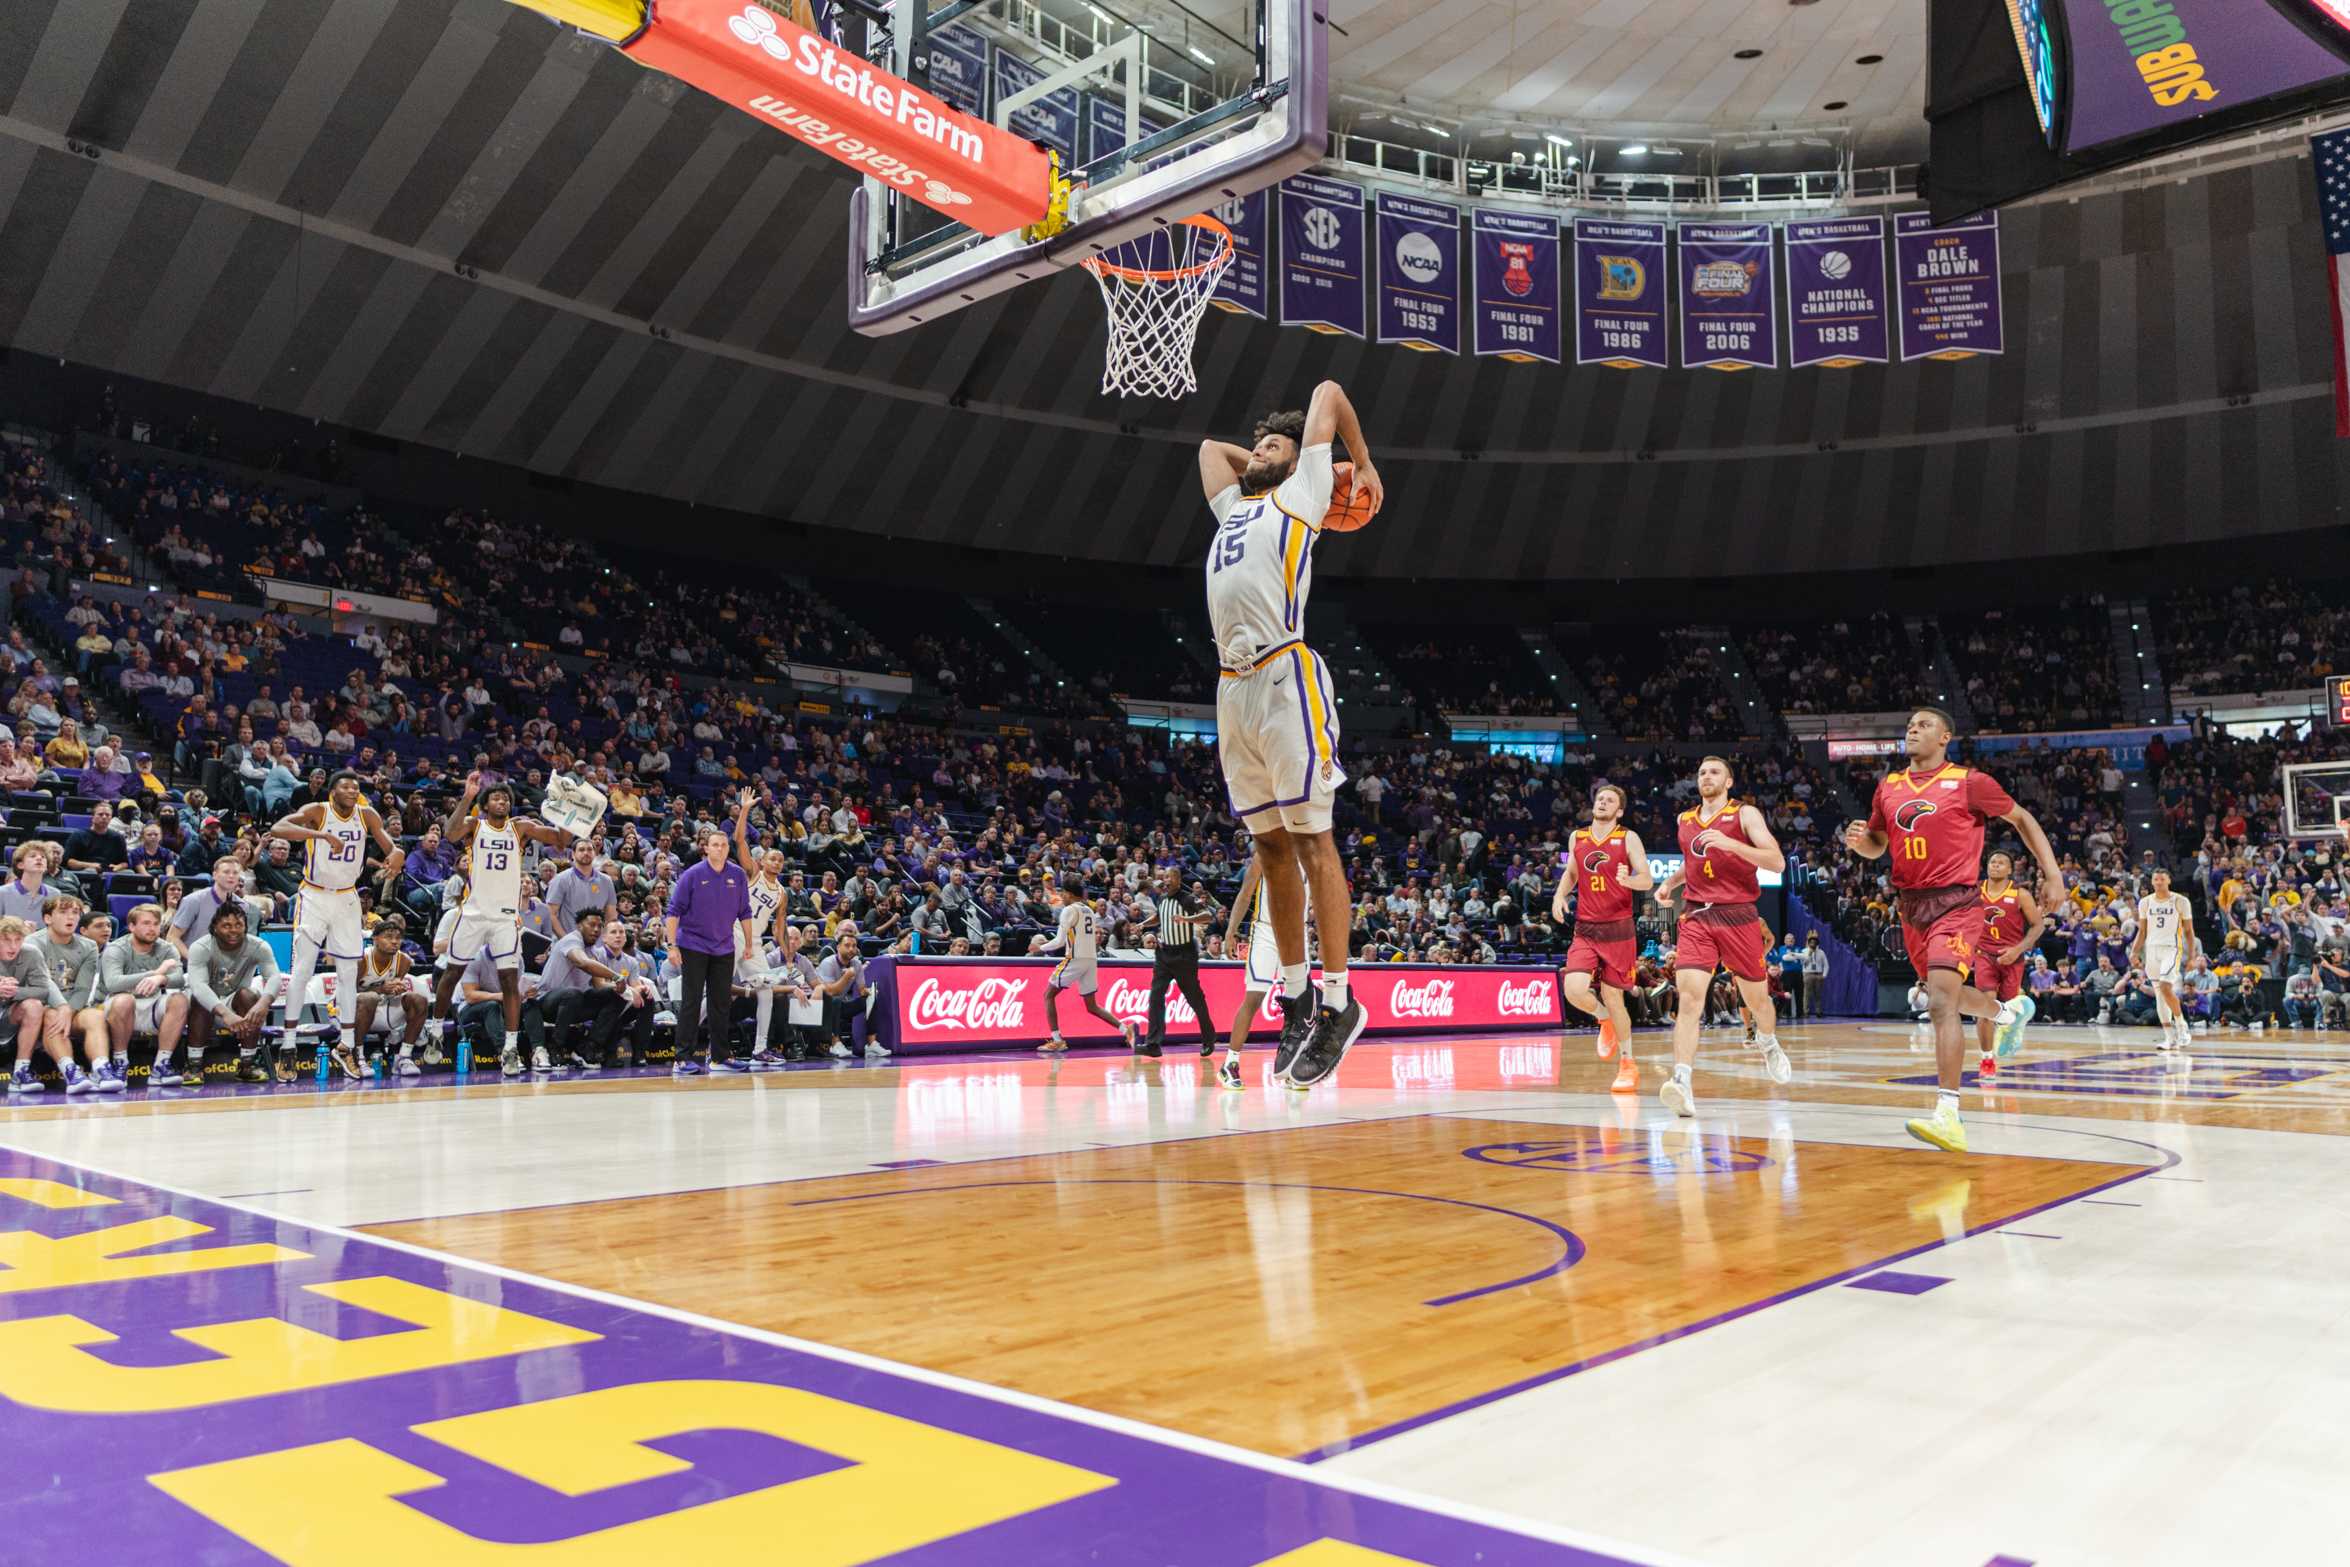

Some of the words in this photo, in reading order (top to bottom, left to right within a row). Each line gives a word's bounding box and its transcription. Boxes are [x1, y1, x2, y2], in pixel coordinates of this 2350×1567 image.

[2104, 0, 2220, 106] SUBWA
[1303, 207, 1341, 250] SEC
[1824, 223, 1869, 234] BASKETBALL
[1300, 252, 1345, 268] CHAMPIONS
[1927, 246, 1968, 262] DALE
[1401, 254, 1440, 272] NCAA
[1917, 259, 1979, 278] BROWN
[1807, 288, 1867, 302] NATIONAL
[1393, 297, 1418, 311] FINAL
[1421, 301, 1445, 315] FOUR
[1801, 299, 1874, 314] CHAMPIONS
[1401, 310, 1437, 331] 1953
[1491, 310, 1517, 323] FINAL
[1519, 313, 1544, 326] FOUR
[1594, 319, 1621, 330] FINAL
[1624, 320, 1650, 332] FOUR
[1699, 321, 1727, 332] FINAL
[1730, 321, 1756, 332] FOUR
[1501, 324, 1534, 342] 1981
[1602, 331, 1641, 348] 1986
[1817, 326, 1860, 343] 1935
[1706, 334, 1750, 350] 2006
[1213, 528, 1248, 574] 15
[480, 838, 514, 851] LSU
[1903, 836, 1927, 860] 10
[486, 853, 508, 870] 13
[1703, 859, 1714, 879] 4
[1590, 875, 1606, 892] 21
[751, 887, 777, 909] LSU
[753, 905, 763, 919] 1
[2149, 908, 2173, 916] LSU
[1085, 916, 1093, 934] 2
[2156, 917, 2165, 928] 3
[909, 977, 1028, 1030] Coca-Cola
[1391, 979, 1454, 1017] Coca-Cola
[1498, 980, 1551, 1015] Coca-Cola
